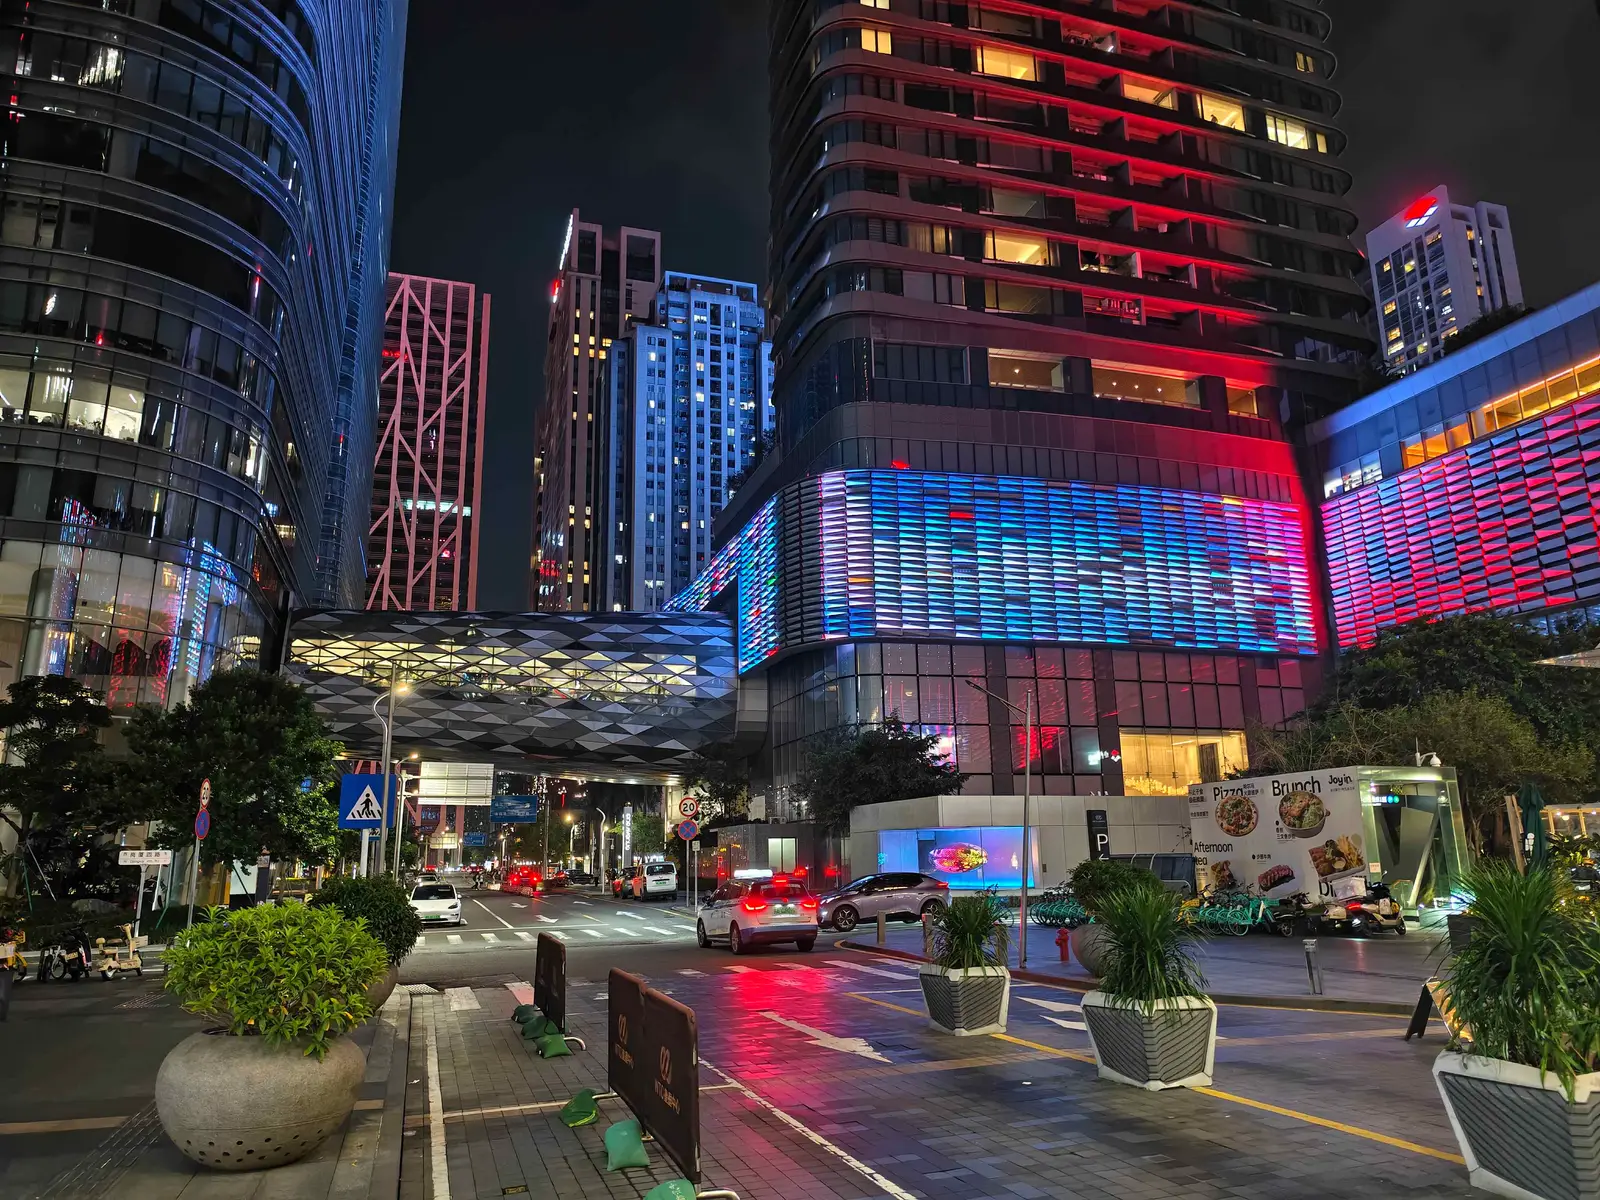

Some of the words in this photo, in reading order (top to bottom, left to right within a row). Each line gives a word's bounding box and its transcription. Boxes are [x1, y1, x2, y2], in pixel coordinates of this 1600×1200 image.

[1272, 776, 1321, 796] Brunch
[1213, 786, 1243, 801] Pizza
[682, 803, 695, 812] 20
[1096, 833, 1109, 851] P
[1194, 841, 1233, 853] Afternoon
[1195, 856, 1208, 866] tea
